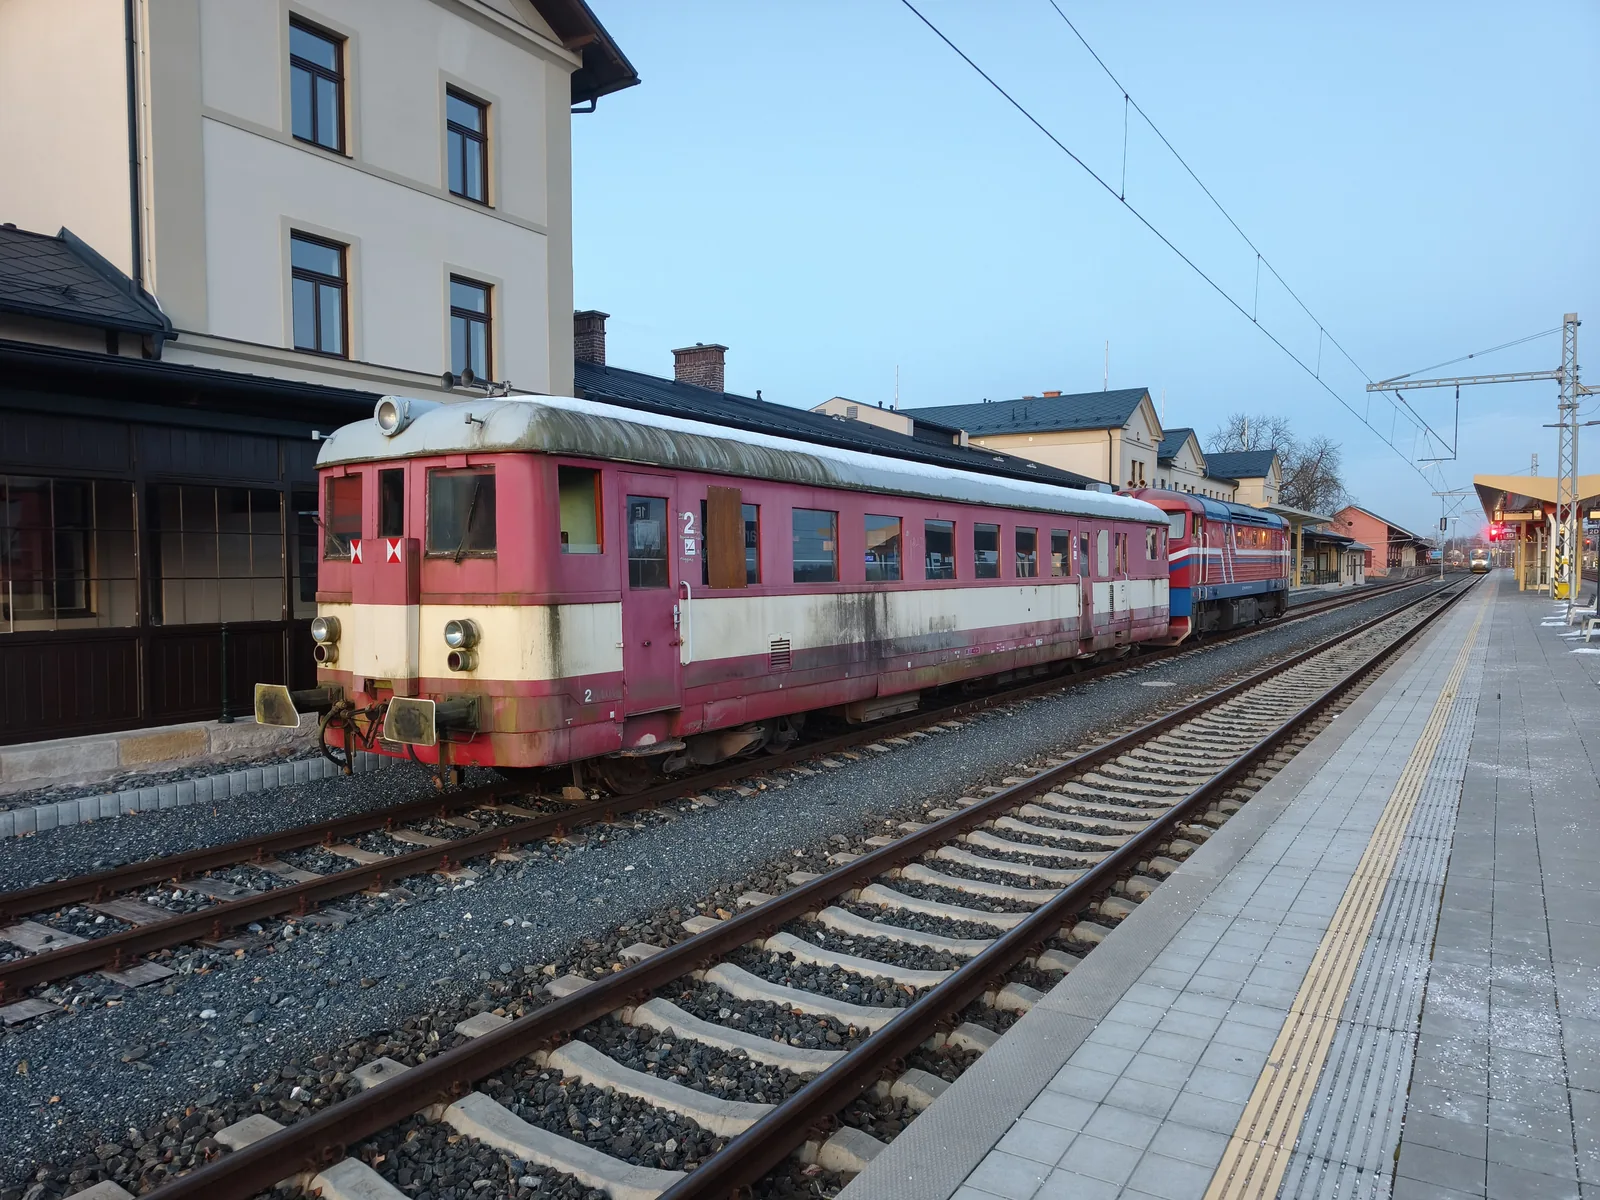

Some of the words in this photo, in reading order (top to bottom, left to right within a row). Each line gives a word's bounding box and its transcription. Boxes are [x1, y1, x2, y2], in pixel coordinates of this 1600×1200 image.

[683, 511, 695, 534] 2
[1073, 536, 1077, 548] 2
[584, 688, 592, 703] 2
